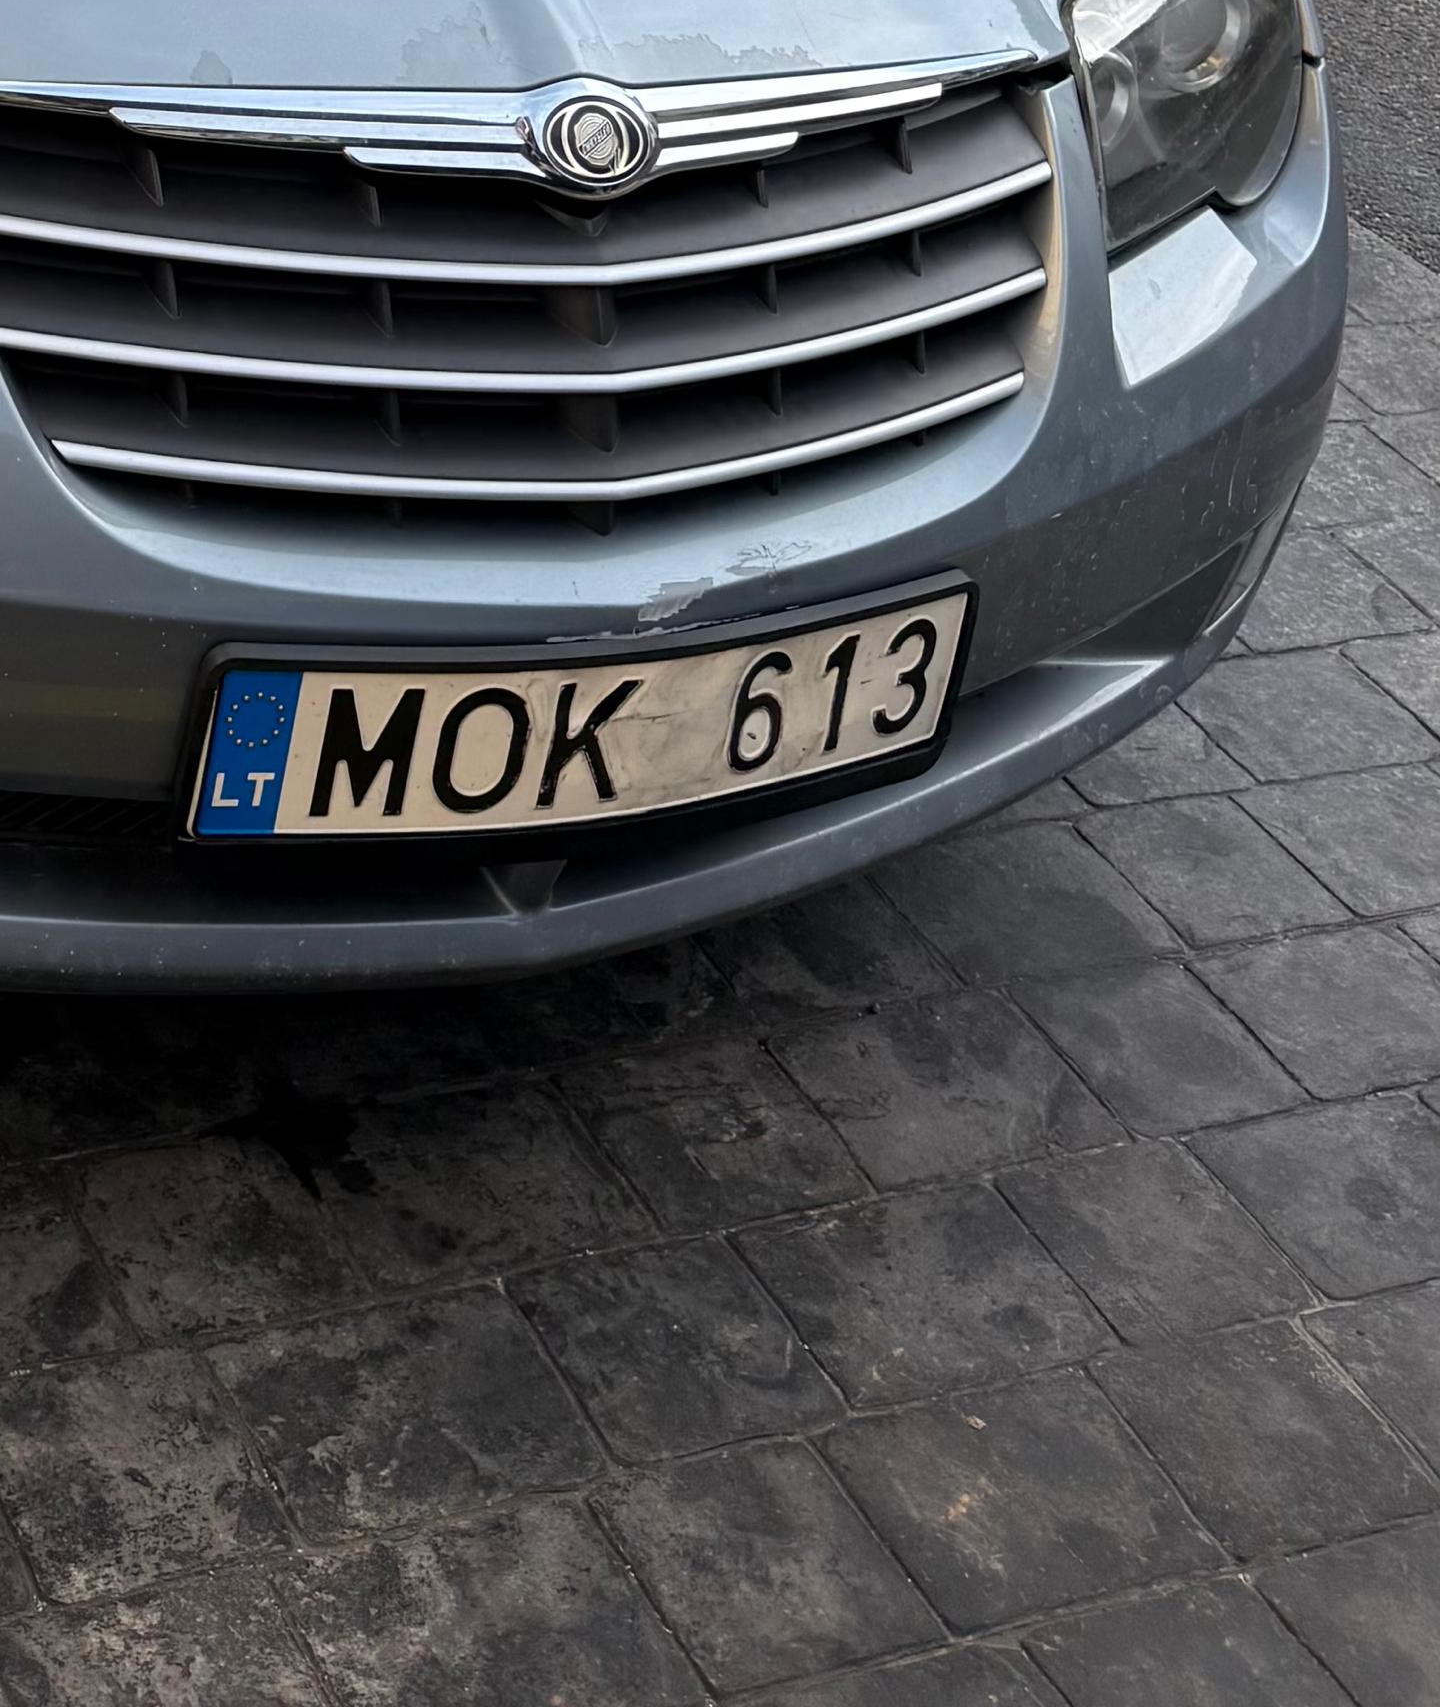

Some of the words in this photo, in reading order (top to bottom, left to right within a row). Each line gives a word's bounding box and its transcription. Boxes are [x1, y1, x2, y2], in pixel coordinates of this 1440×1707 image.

[309, 679, 644, 818] MOK
[726, 618, 937, 773] 613
[210, 771, 276, 808] LT
